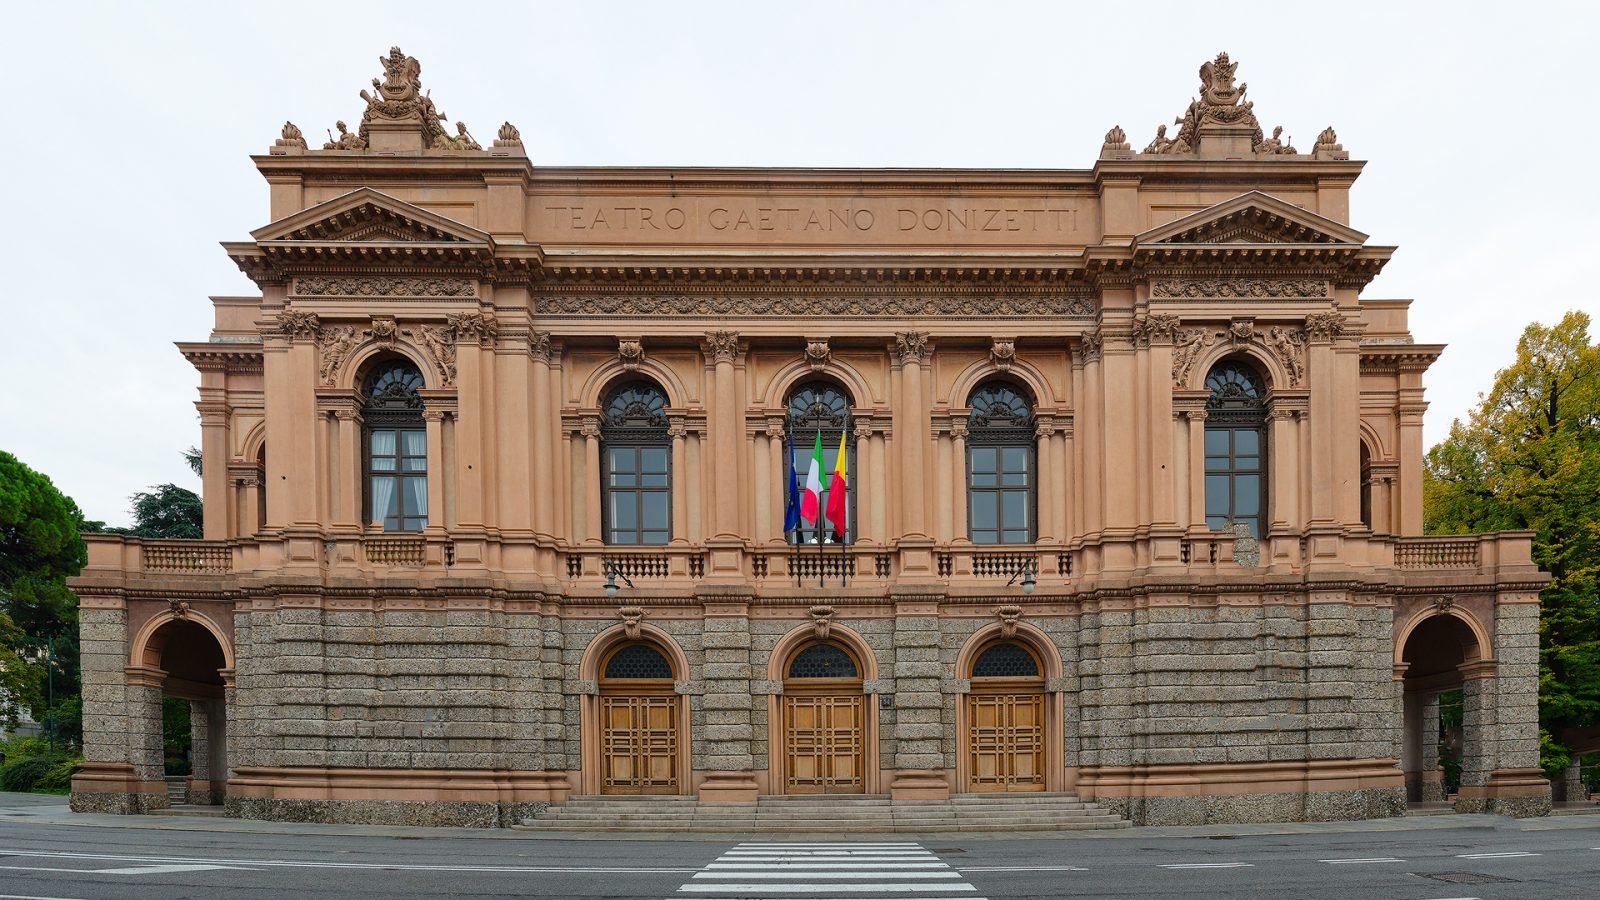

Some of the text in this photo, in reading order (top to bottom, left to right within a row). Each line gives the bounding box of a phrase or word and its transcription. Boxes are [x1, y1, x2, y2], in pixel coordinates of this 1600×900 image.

[545, 207, 1079, 232] TEATRO GAETANO DONIZETTI
